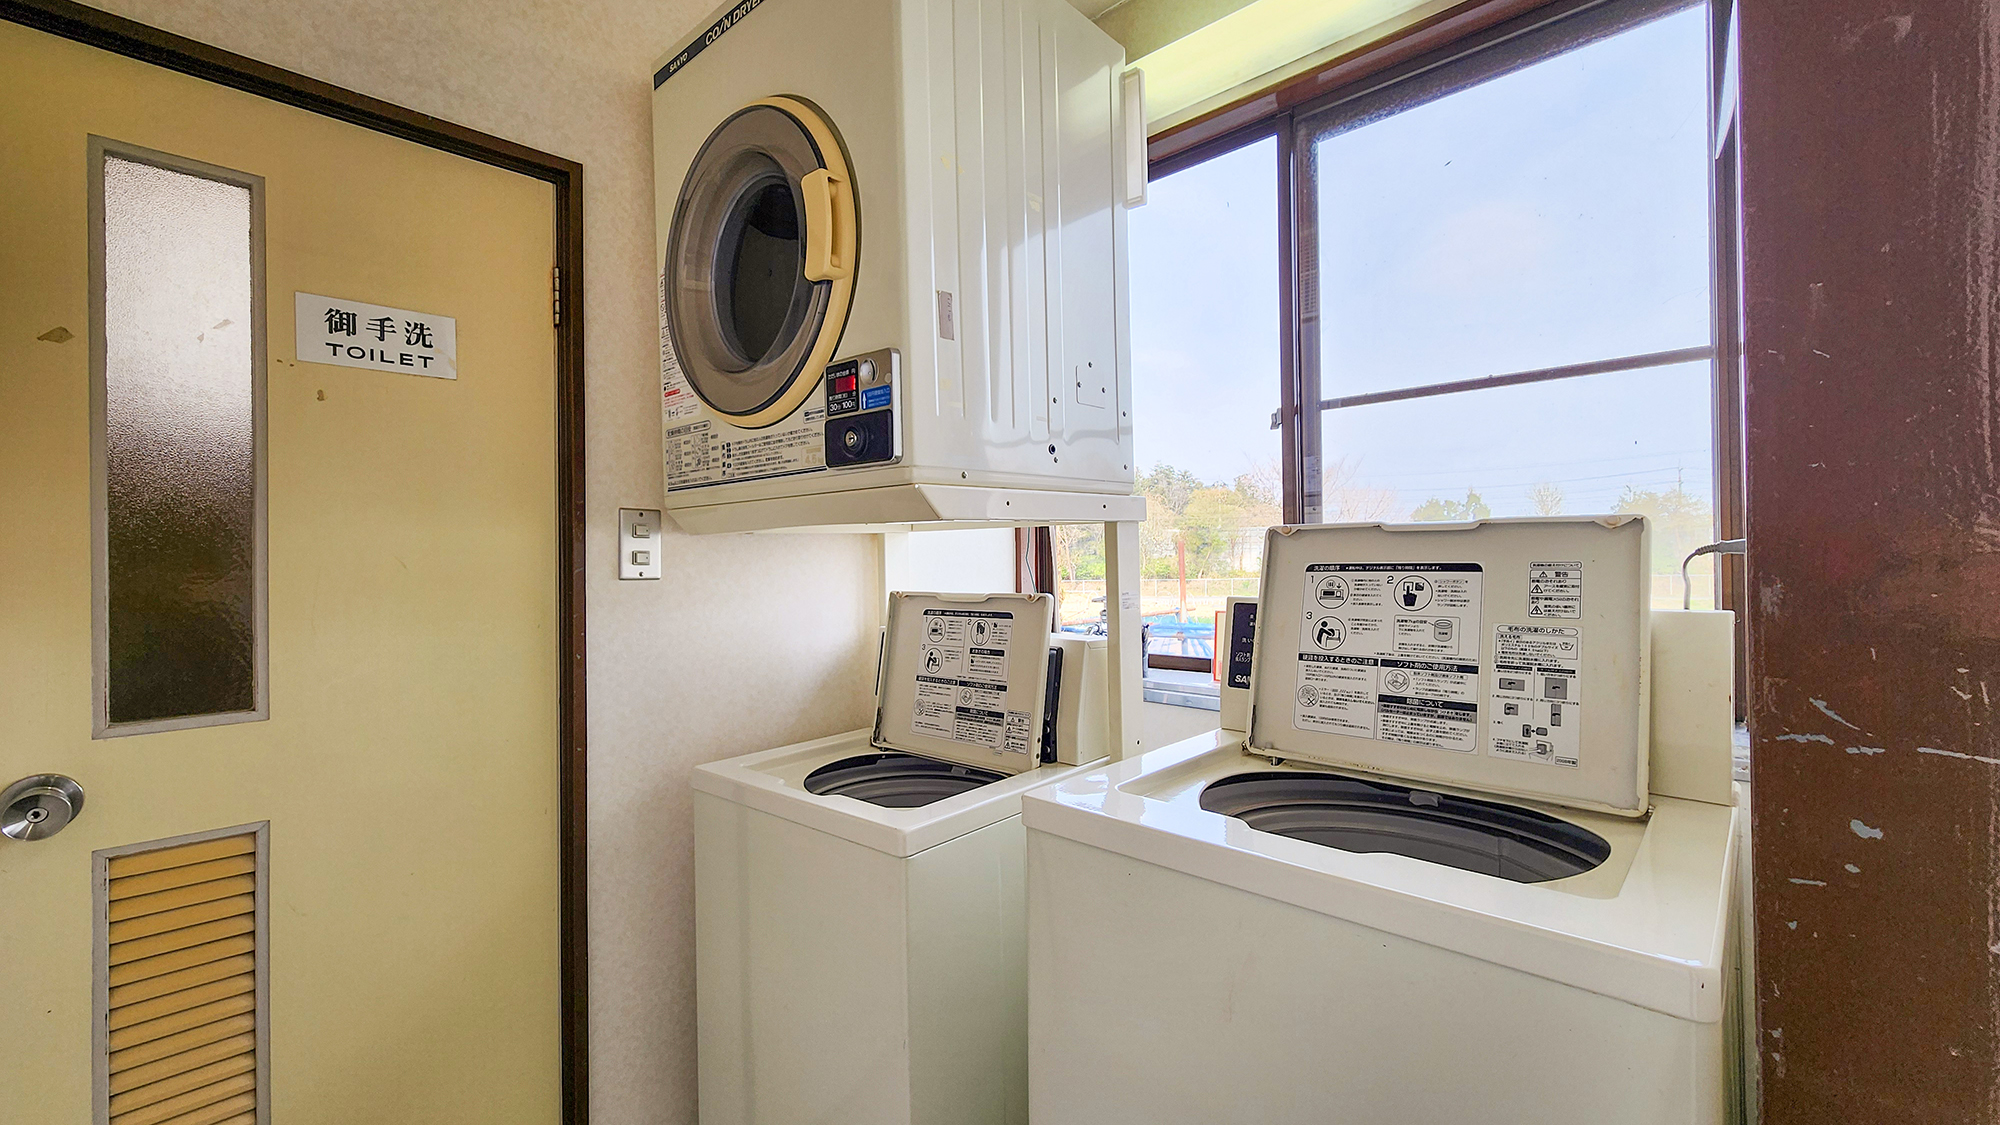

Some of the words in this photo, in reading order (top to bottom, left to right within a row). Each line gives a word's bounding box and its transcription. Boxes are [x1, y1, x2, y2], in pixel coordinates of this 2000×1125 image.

[705, 15, 732, 46] COIN
[732, 0, 761, 24] DRYE
[324, 307, 434, 349] 御手洗
[325, 342, 434, 369] TOILET
[1310, 575, 1314, 584] 1
[1386, 575, 1395, 584] 2
[1305, 611, 1313, 620] 3
[967, 618, 972, 626] 2
[1508, 626, 1565, 635] 毛布の洗濯のしかた
[921, 643, 927, 651] 3
[1397, 661, 1458, 672] ソフト剤のご使用方法
